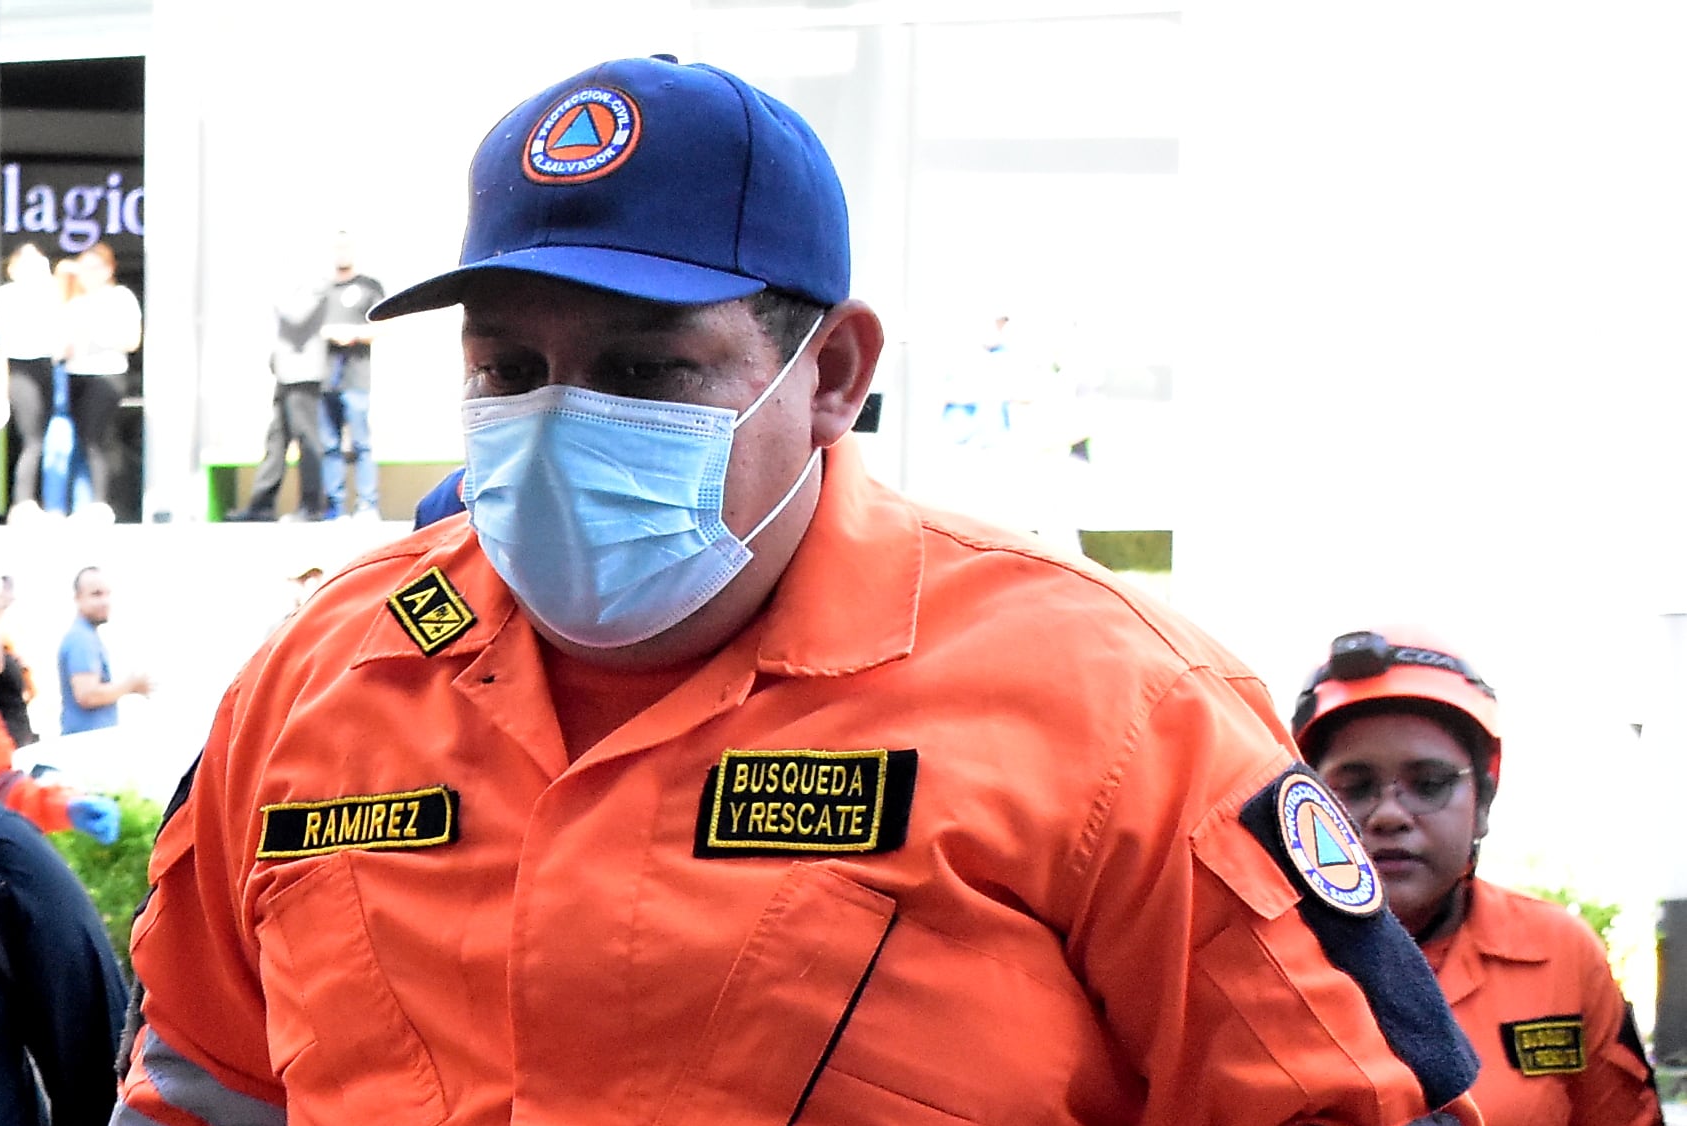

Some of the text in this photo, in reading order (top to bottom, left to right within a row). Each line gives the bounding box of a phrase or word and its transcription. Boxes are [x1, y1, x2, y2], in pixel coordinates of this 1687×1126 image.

[611, 99, 630, 131] CIVIL
[542, 146, 616, 172] SALVADOR
[733, 762, 863, 797] BUSQUEDA
[303, 801, 420, 848] RAMIREZ
[748, 802, 867, 836] RESCATE
